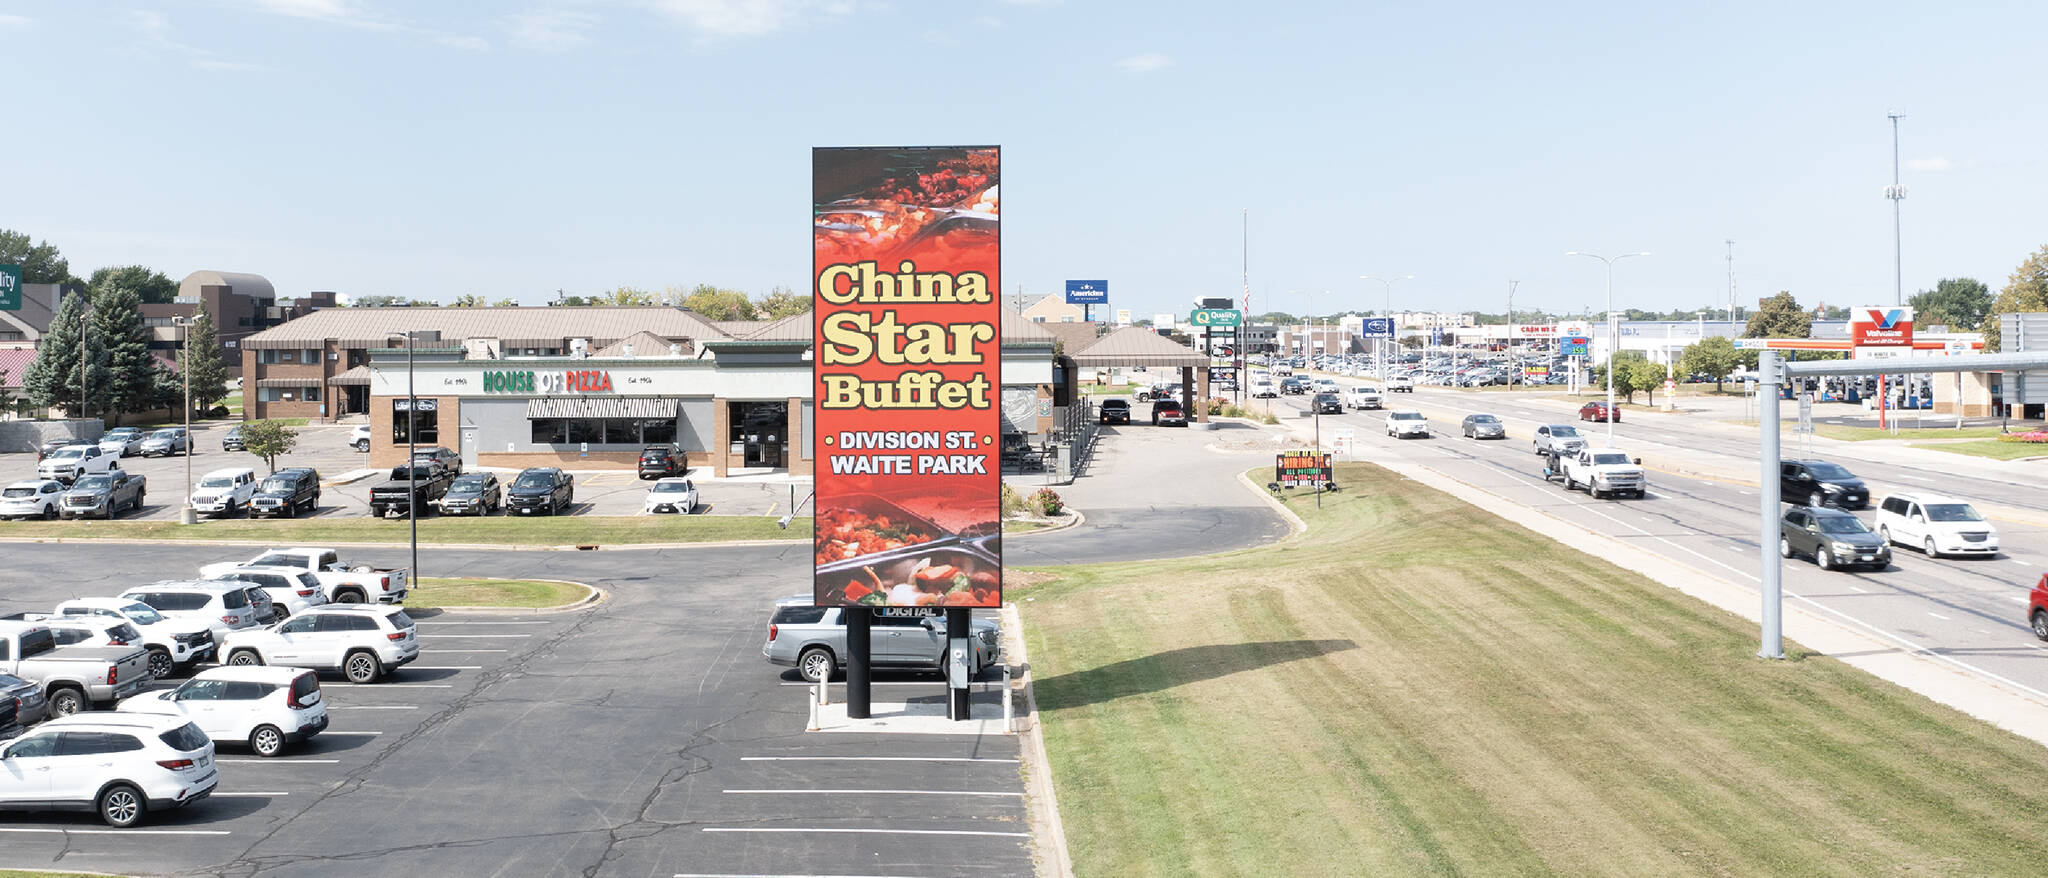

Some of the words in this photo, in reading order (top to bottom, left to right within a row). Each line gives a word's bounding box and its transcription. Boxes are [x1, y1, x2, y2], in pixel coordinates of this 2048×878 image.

[818, 260, 992, 304] China
[822, 311, 995, 366] Star
[483, 371, 535, 392] HOUSE
[542, 371, 561, 392] OF
[566, 371, 612, 392] PIZZA
[821, 373, 991, 410] Buffet
[839, 431, 941, 450] DIVISION
[945, 431, 979, 450] ST.
[830, 455, 912, 475] WAITE
[918, 455, 987, 475] PARK
[1283, 457, 1313, 468] HIRING
